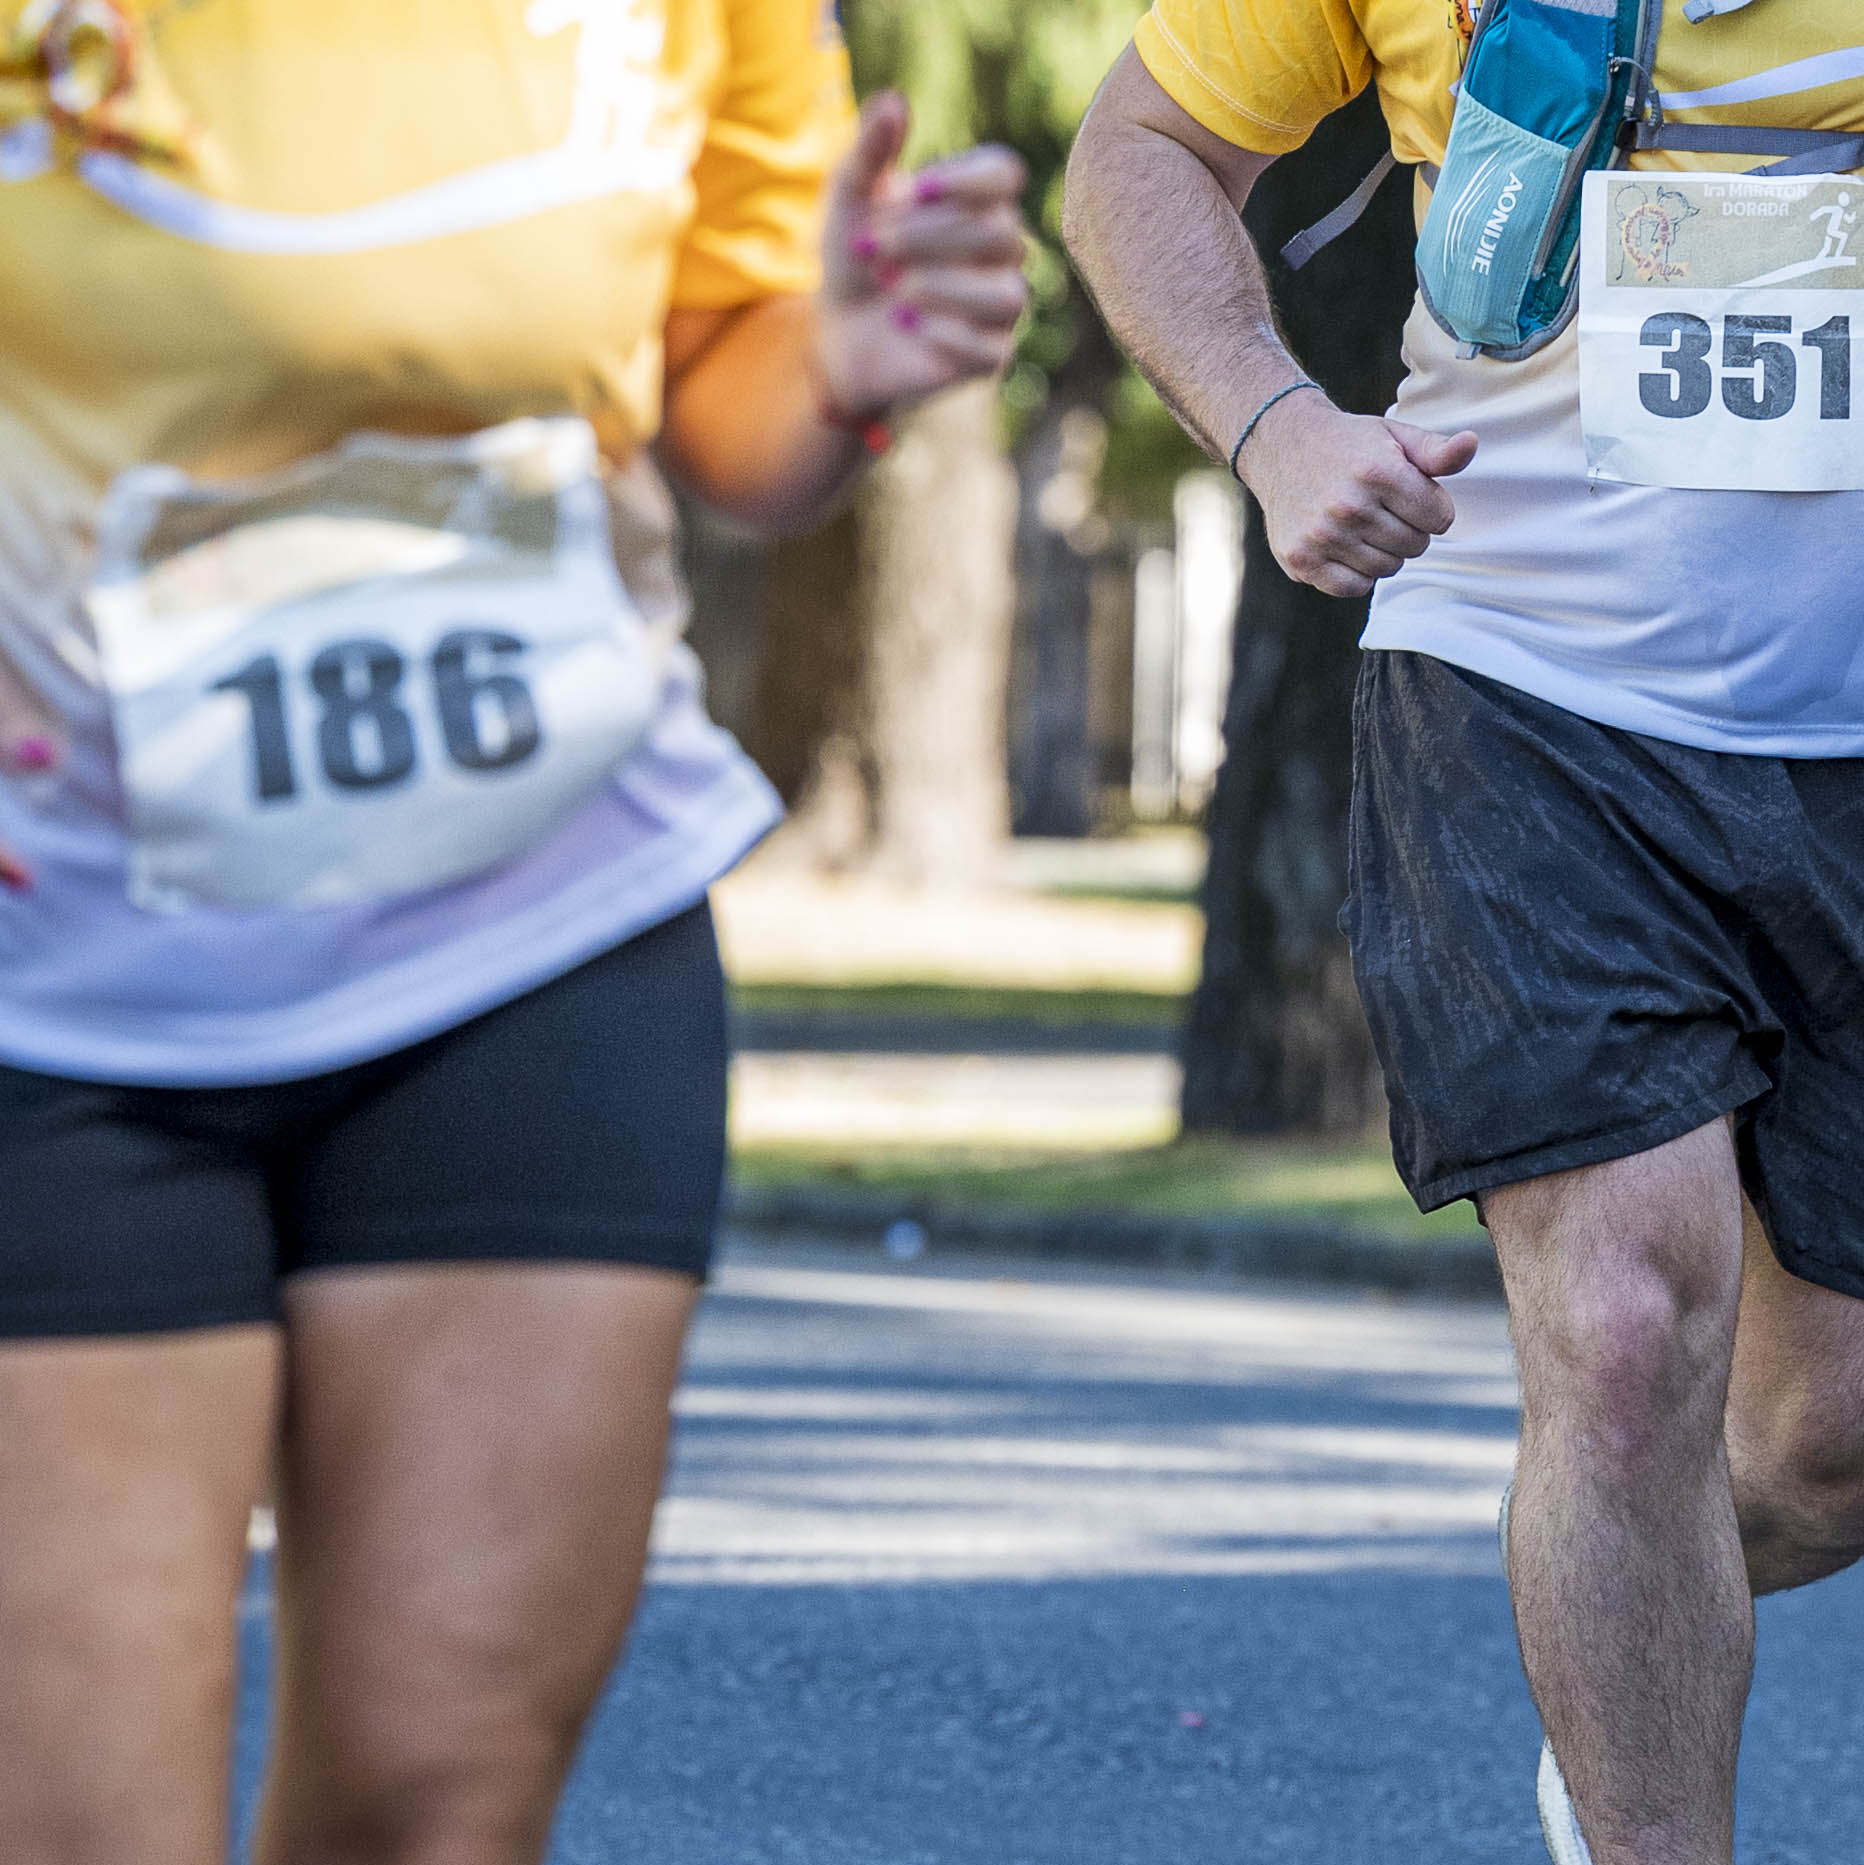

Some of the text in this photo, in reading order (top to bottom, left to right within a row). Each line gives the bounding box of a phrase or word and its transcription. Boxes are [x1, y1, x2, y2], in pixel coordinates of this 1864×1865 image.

[1471, 171, 1524, 276] AONIJIE
[1722, 200, 1790, 217] DORADA
[1638, 312, 1850, 420] 351
[209, 630, 540, 806] 186
